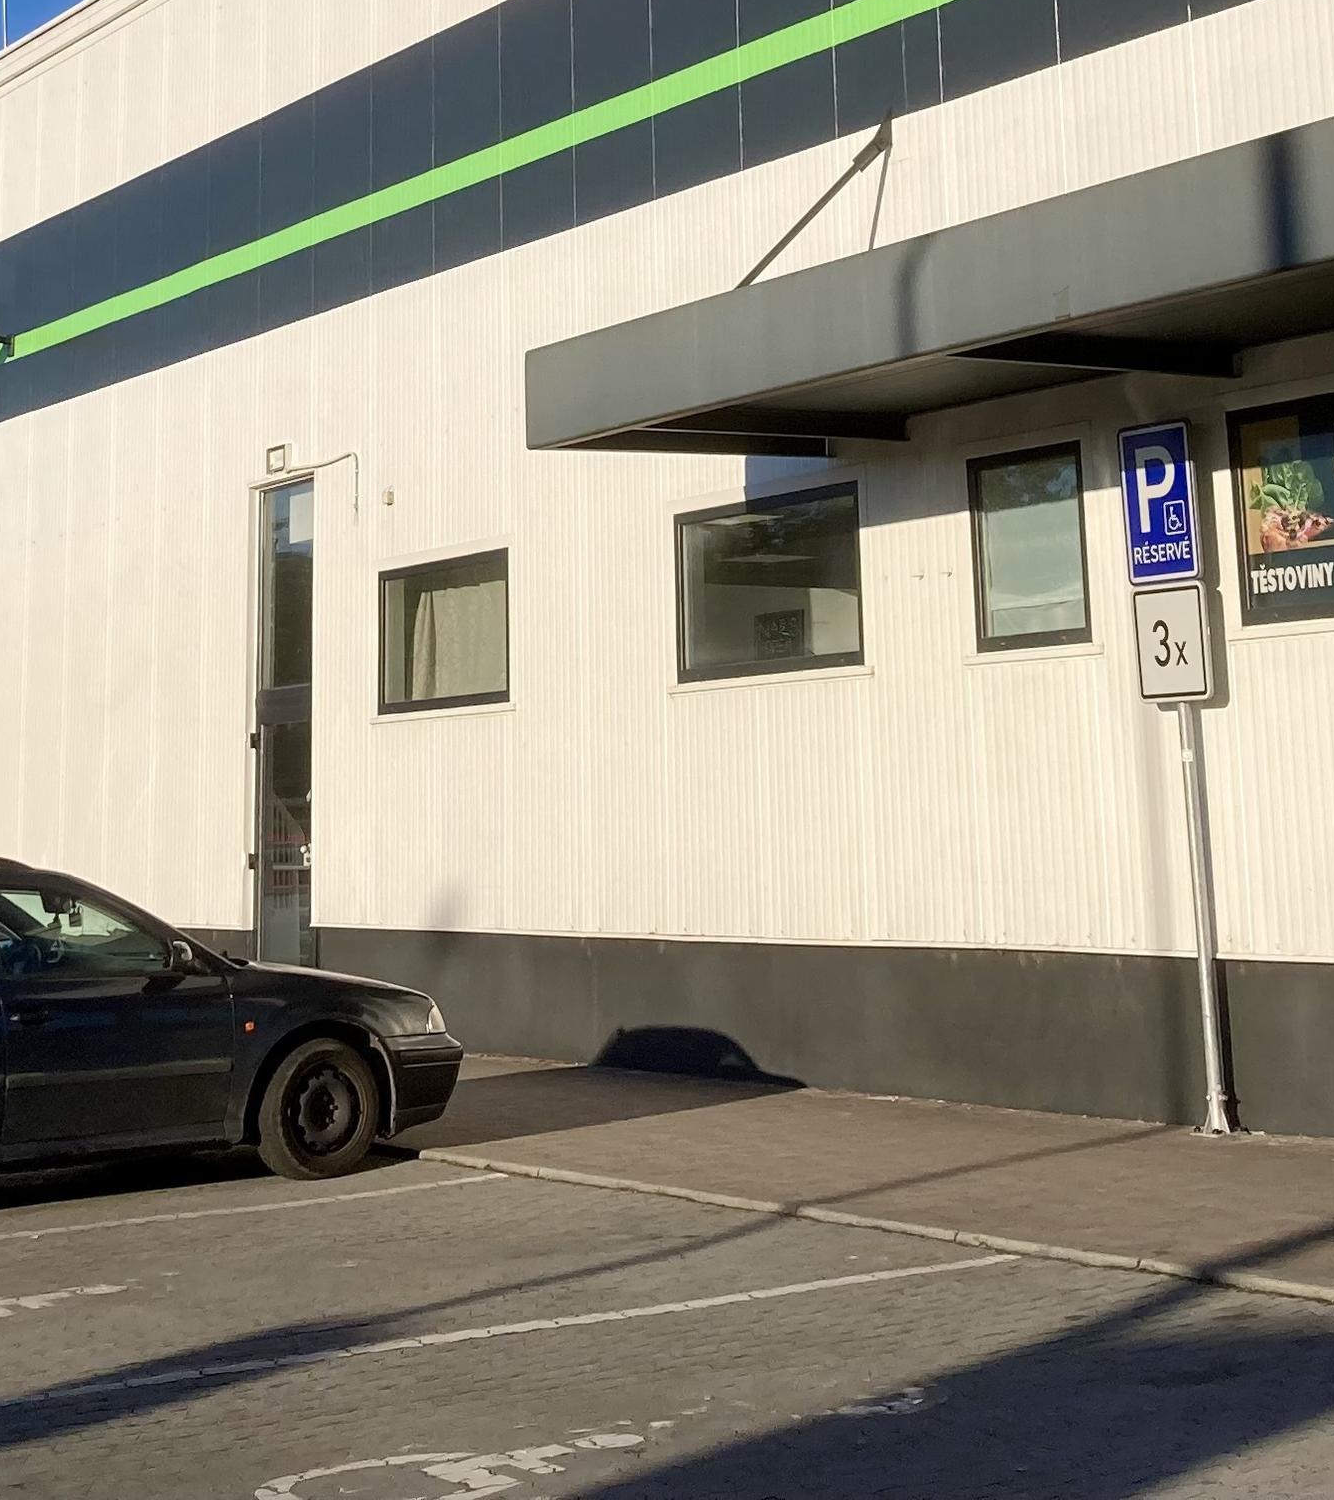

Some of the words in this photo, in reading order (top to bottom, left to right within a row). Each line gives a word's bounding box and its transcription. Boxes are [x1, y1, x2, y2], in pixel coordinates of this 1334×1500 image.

[1134, 445, 1176, 534] P
[1134, 536, 1191, 565] RÉSERVÉ
[1250, 562, 1334, 595] TĚSTOVINY
